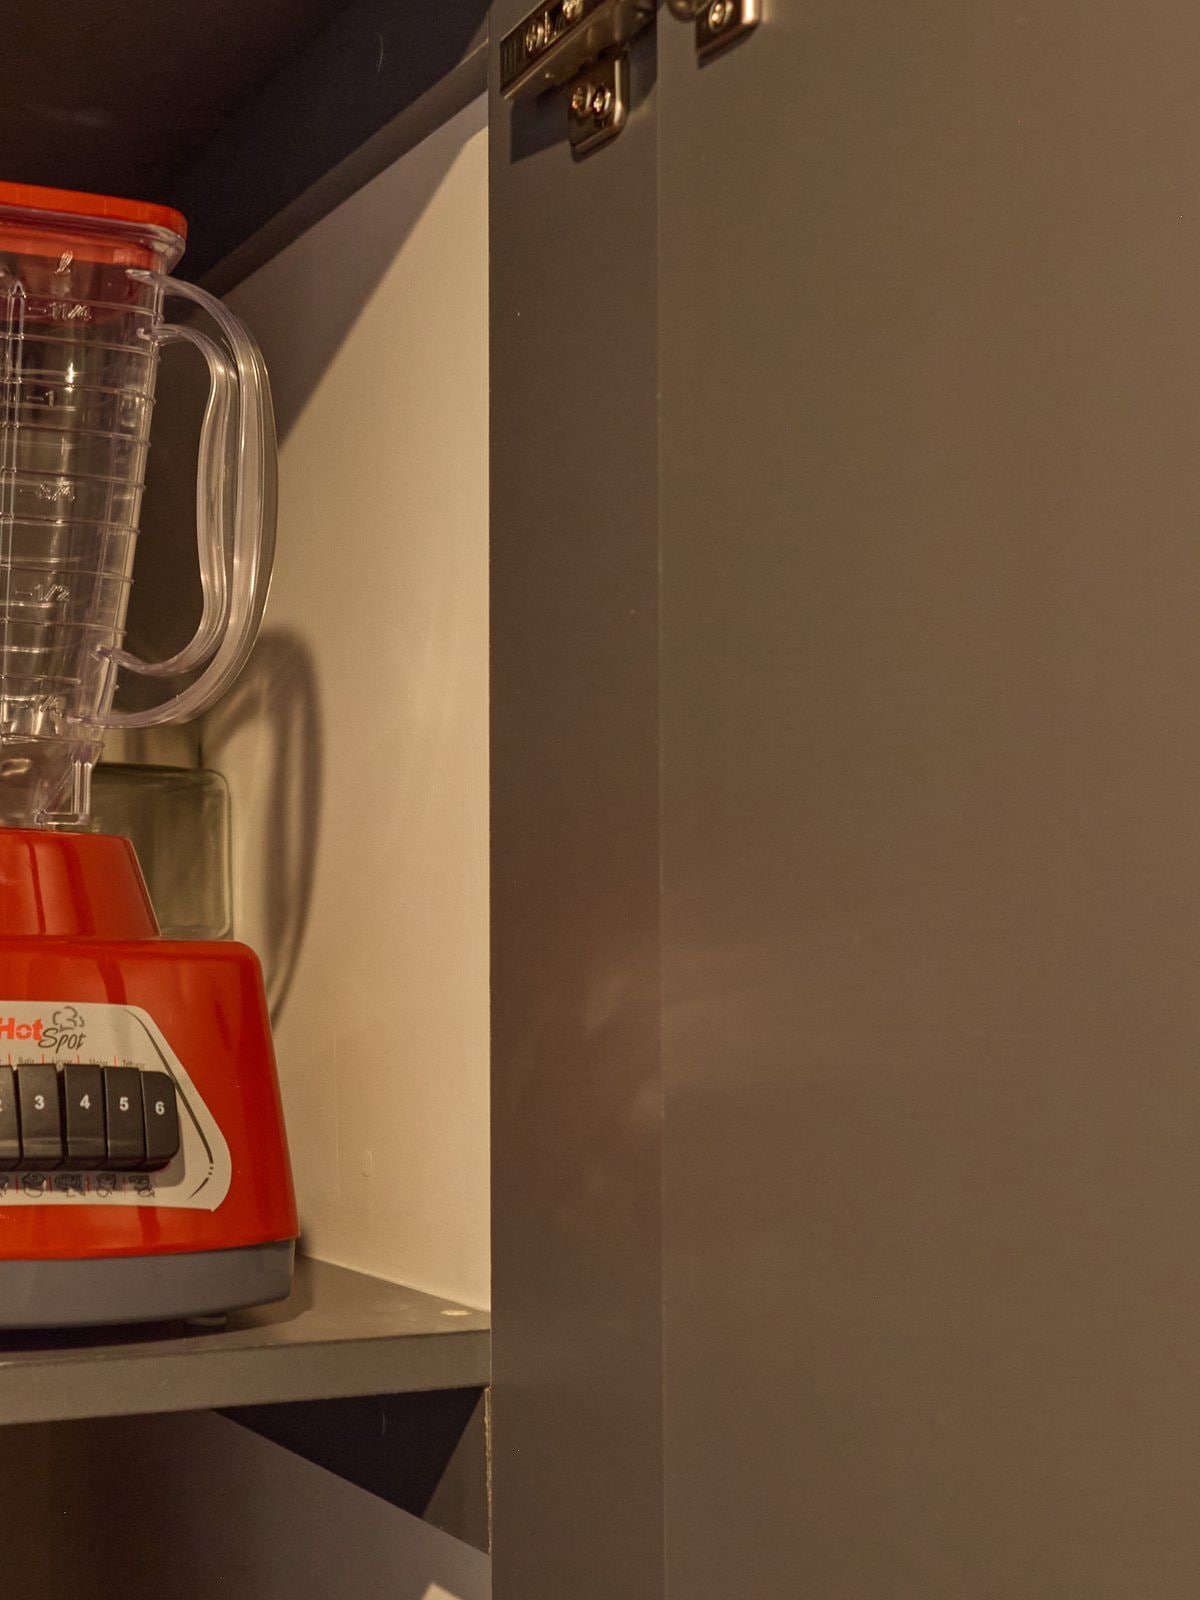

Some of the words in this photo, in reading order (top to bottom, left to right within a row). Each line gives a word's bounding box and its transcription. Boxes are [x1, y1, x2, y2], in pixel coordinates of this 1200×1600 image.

[37, 1027, 87, 1054] Spot
[34, 1095, 45, 1110] 3
[79, 1094, 90, 1109] 4
[119, 1096, 129, 1111] 5
[155, 1100, 165, 1115] 6
